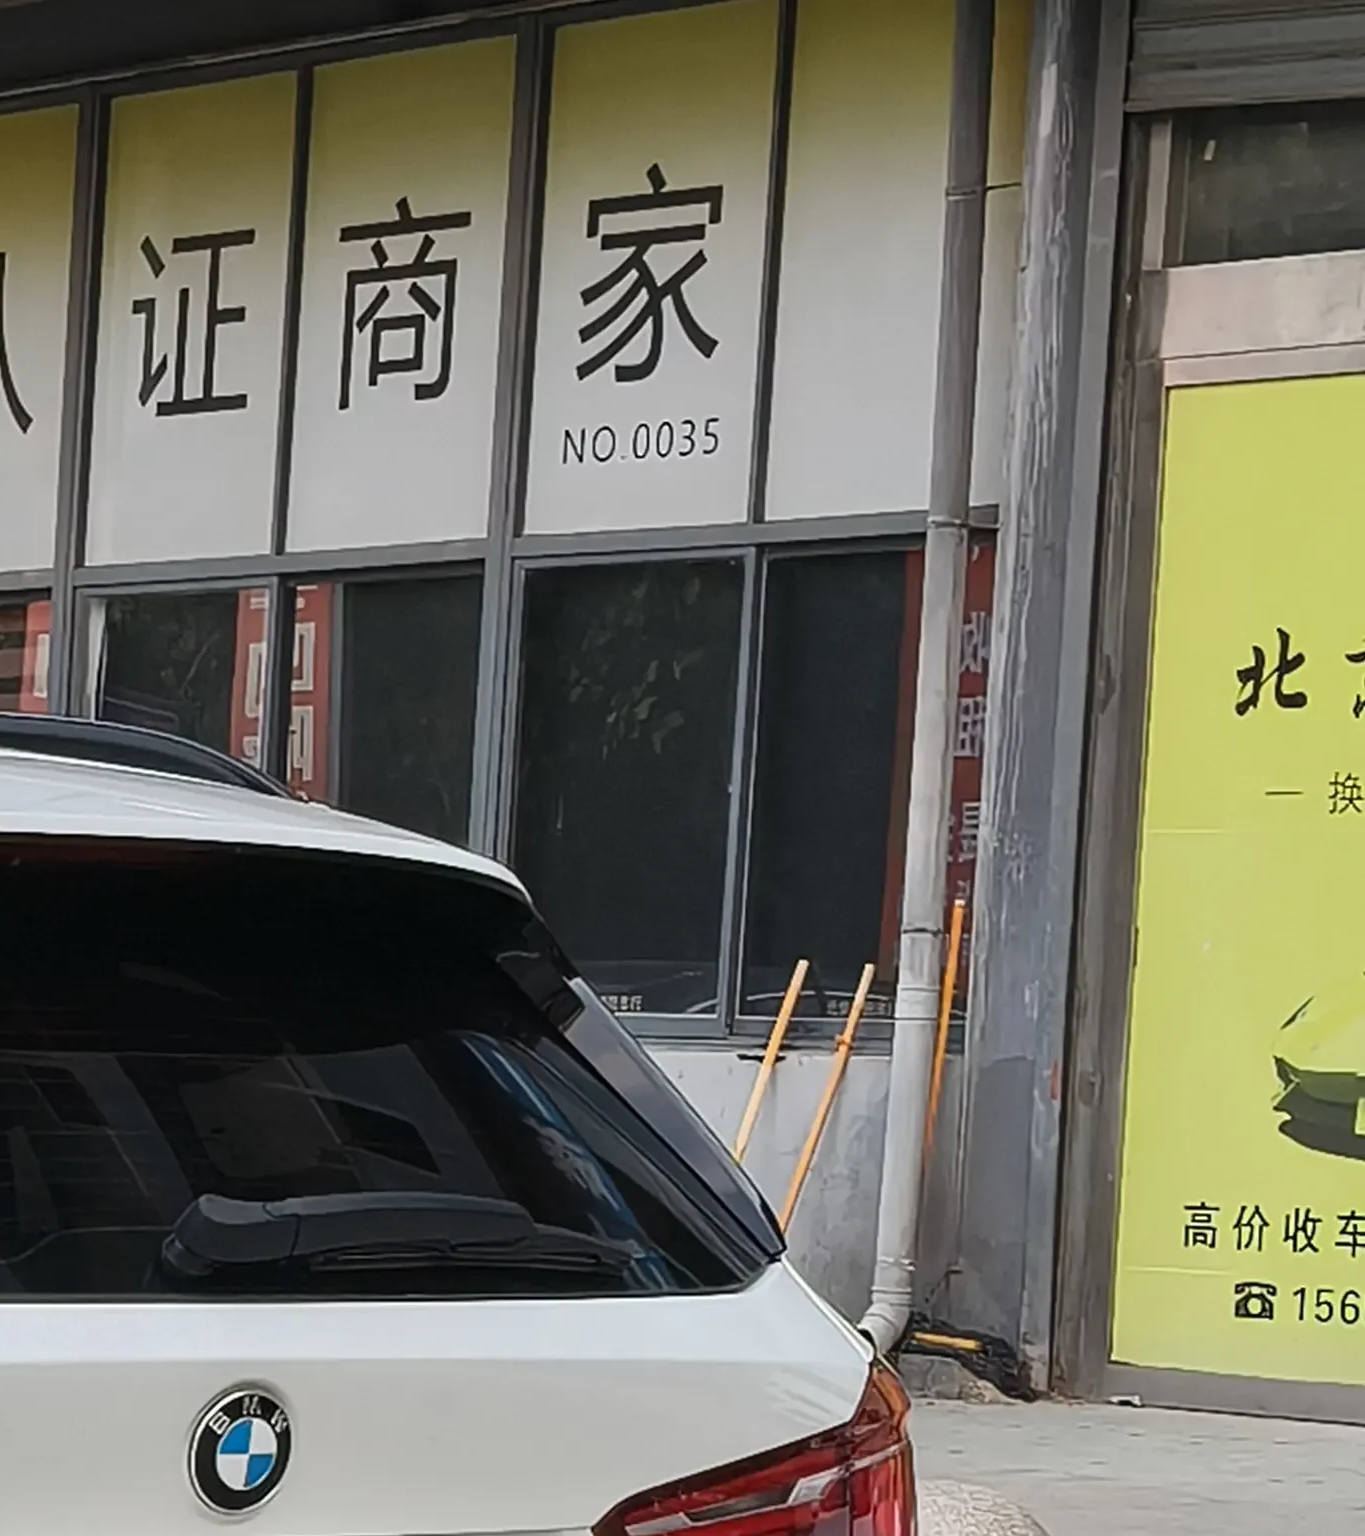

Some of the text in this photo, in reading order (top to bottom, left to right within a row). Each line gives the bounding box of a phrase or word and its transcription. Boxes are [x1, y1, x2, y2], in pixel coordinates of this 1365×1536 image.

[562, 417, 720, 464] NO.0035
[1235, 627, 1365, 717] 北
[1183, 1201, 1365, 1258] 高价收车
